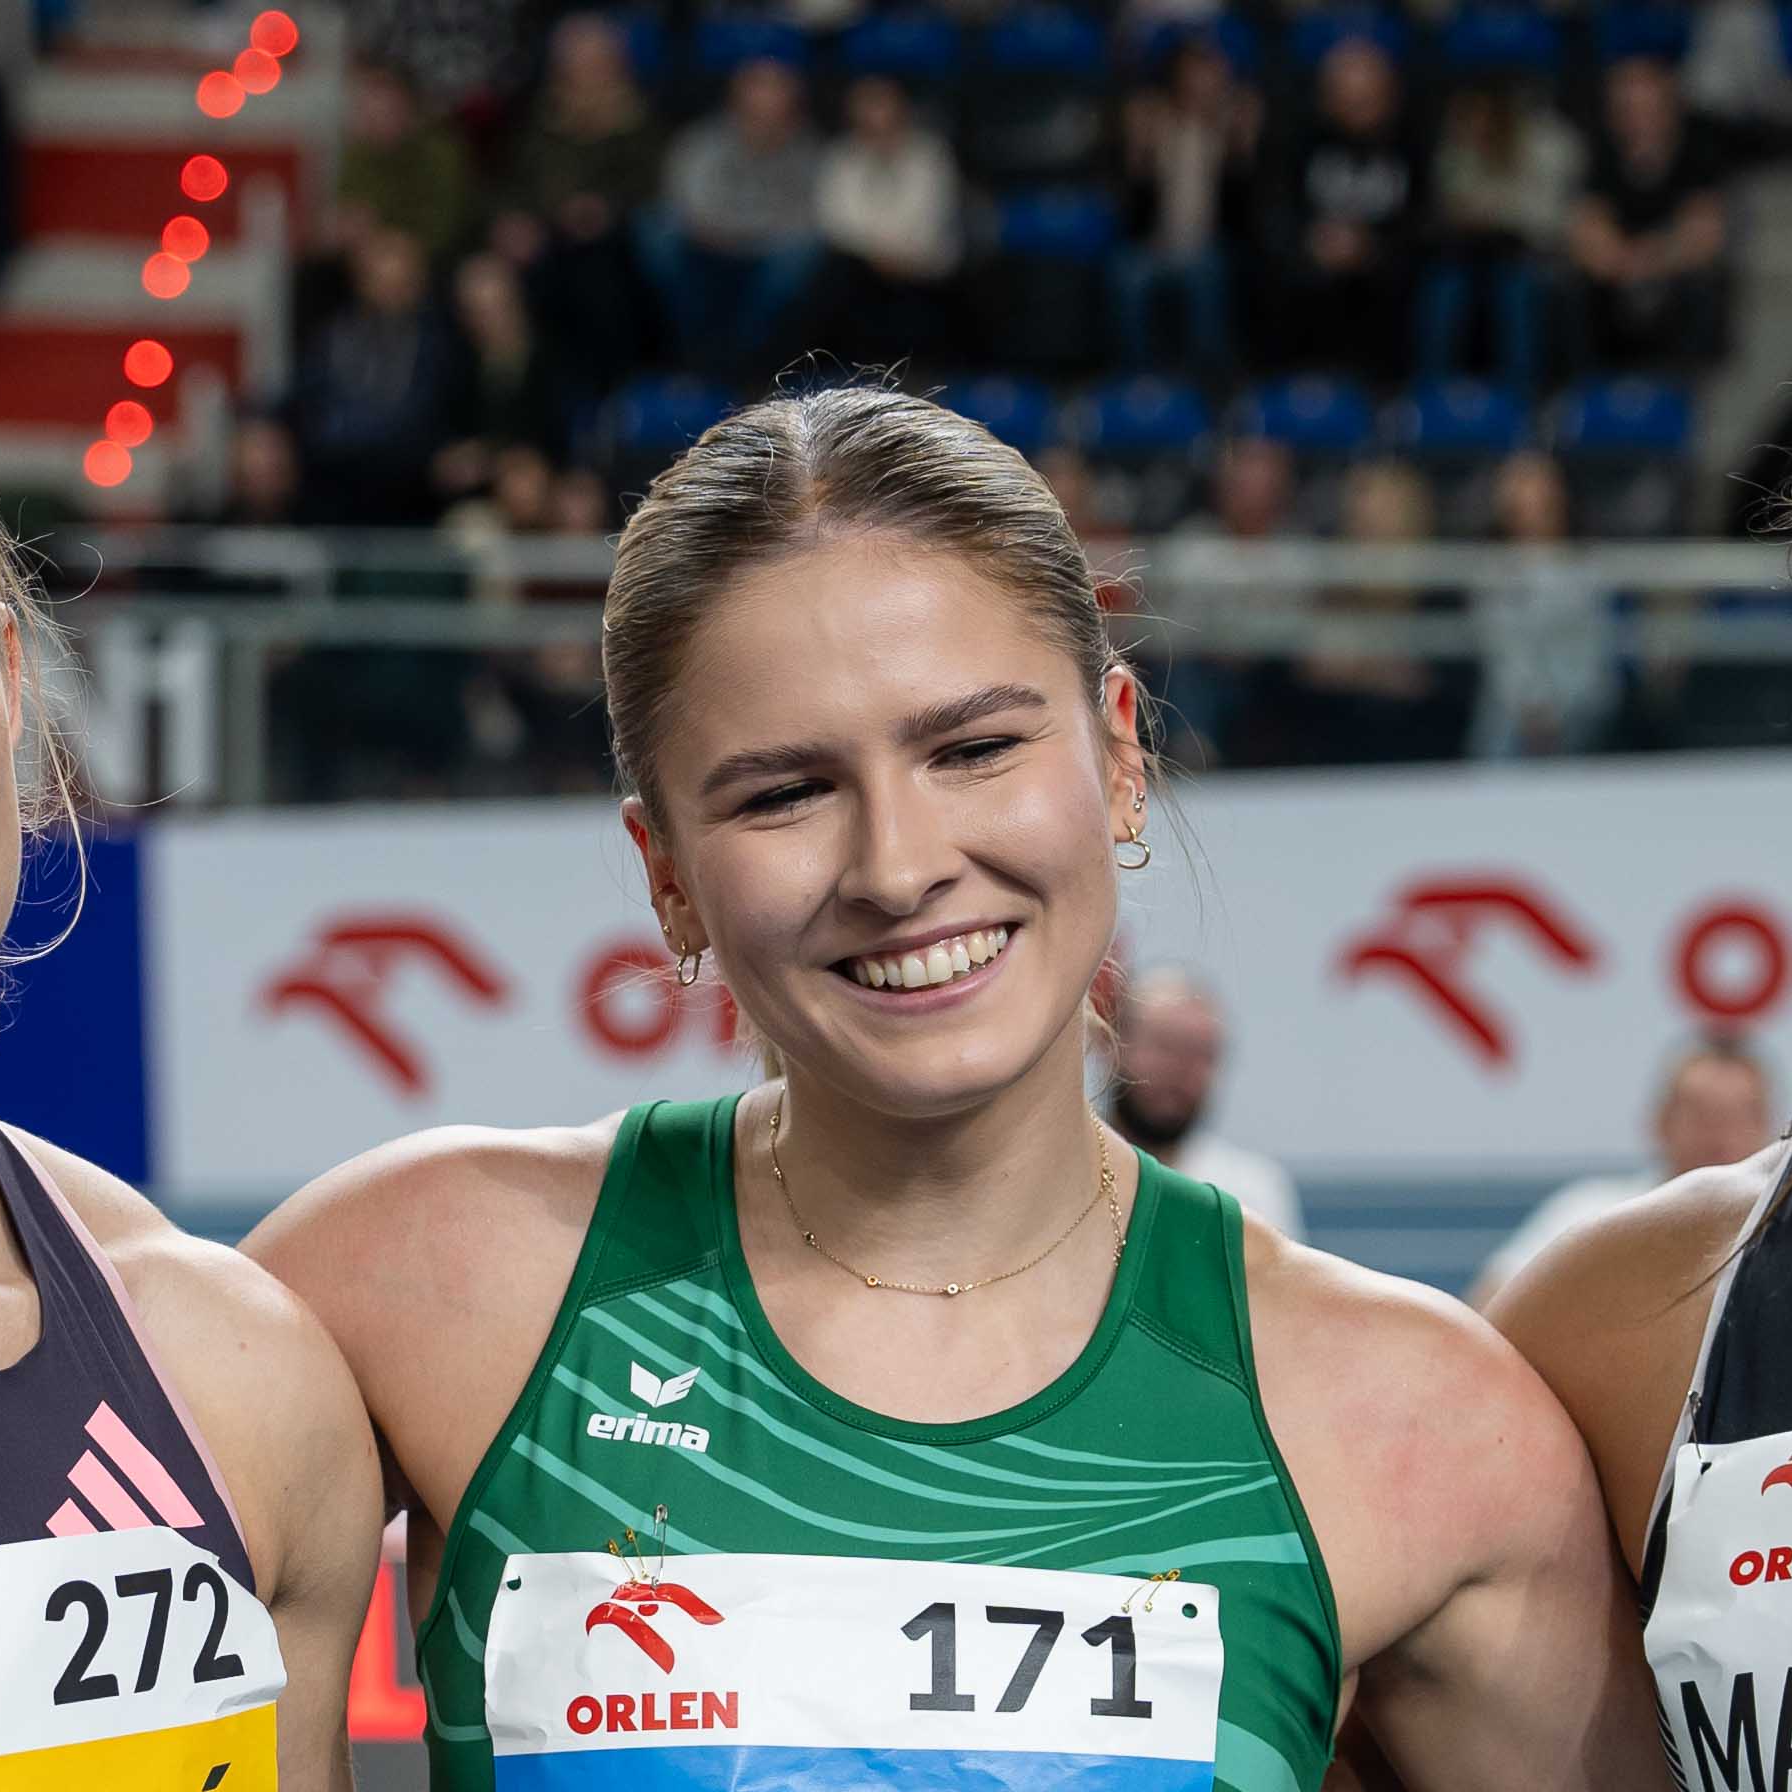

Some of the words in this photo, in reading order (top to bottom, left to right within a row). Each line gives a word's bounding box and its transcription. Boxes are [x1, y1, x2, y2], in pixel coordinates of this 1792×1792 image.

[587, 1410, 710, 1455] erima
[44, 1562, 245, 1705] 272
[900, 1601, 1154, 1720] 171
[566, 1692, 738, 1735] ORLEN
